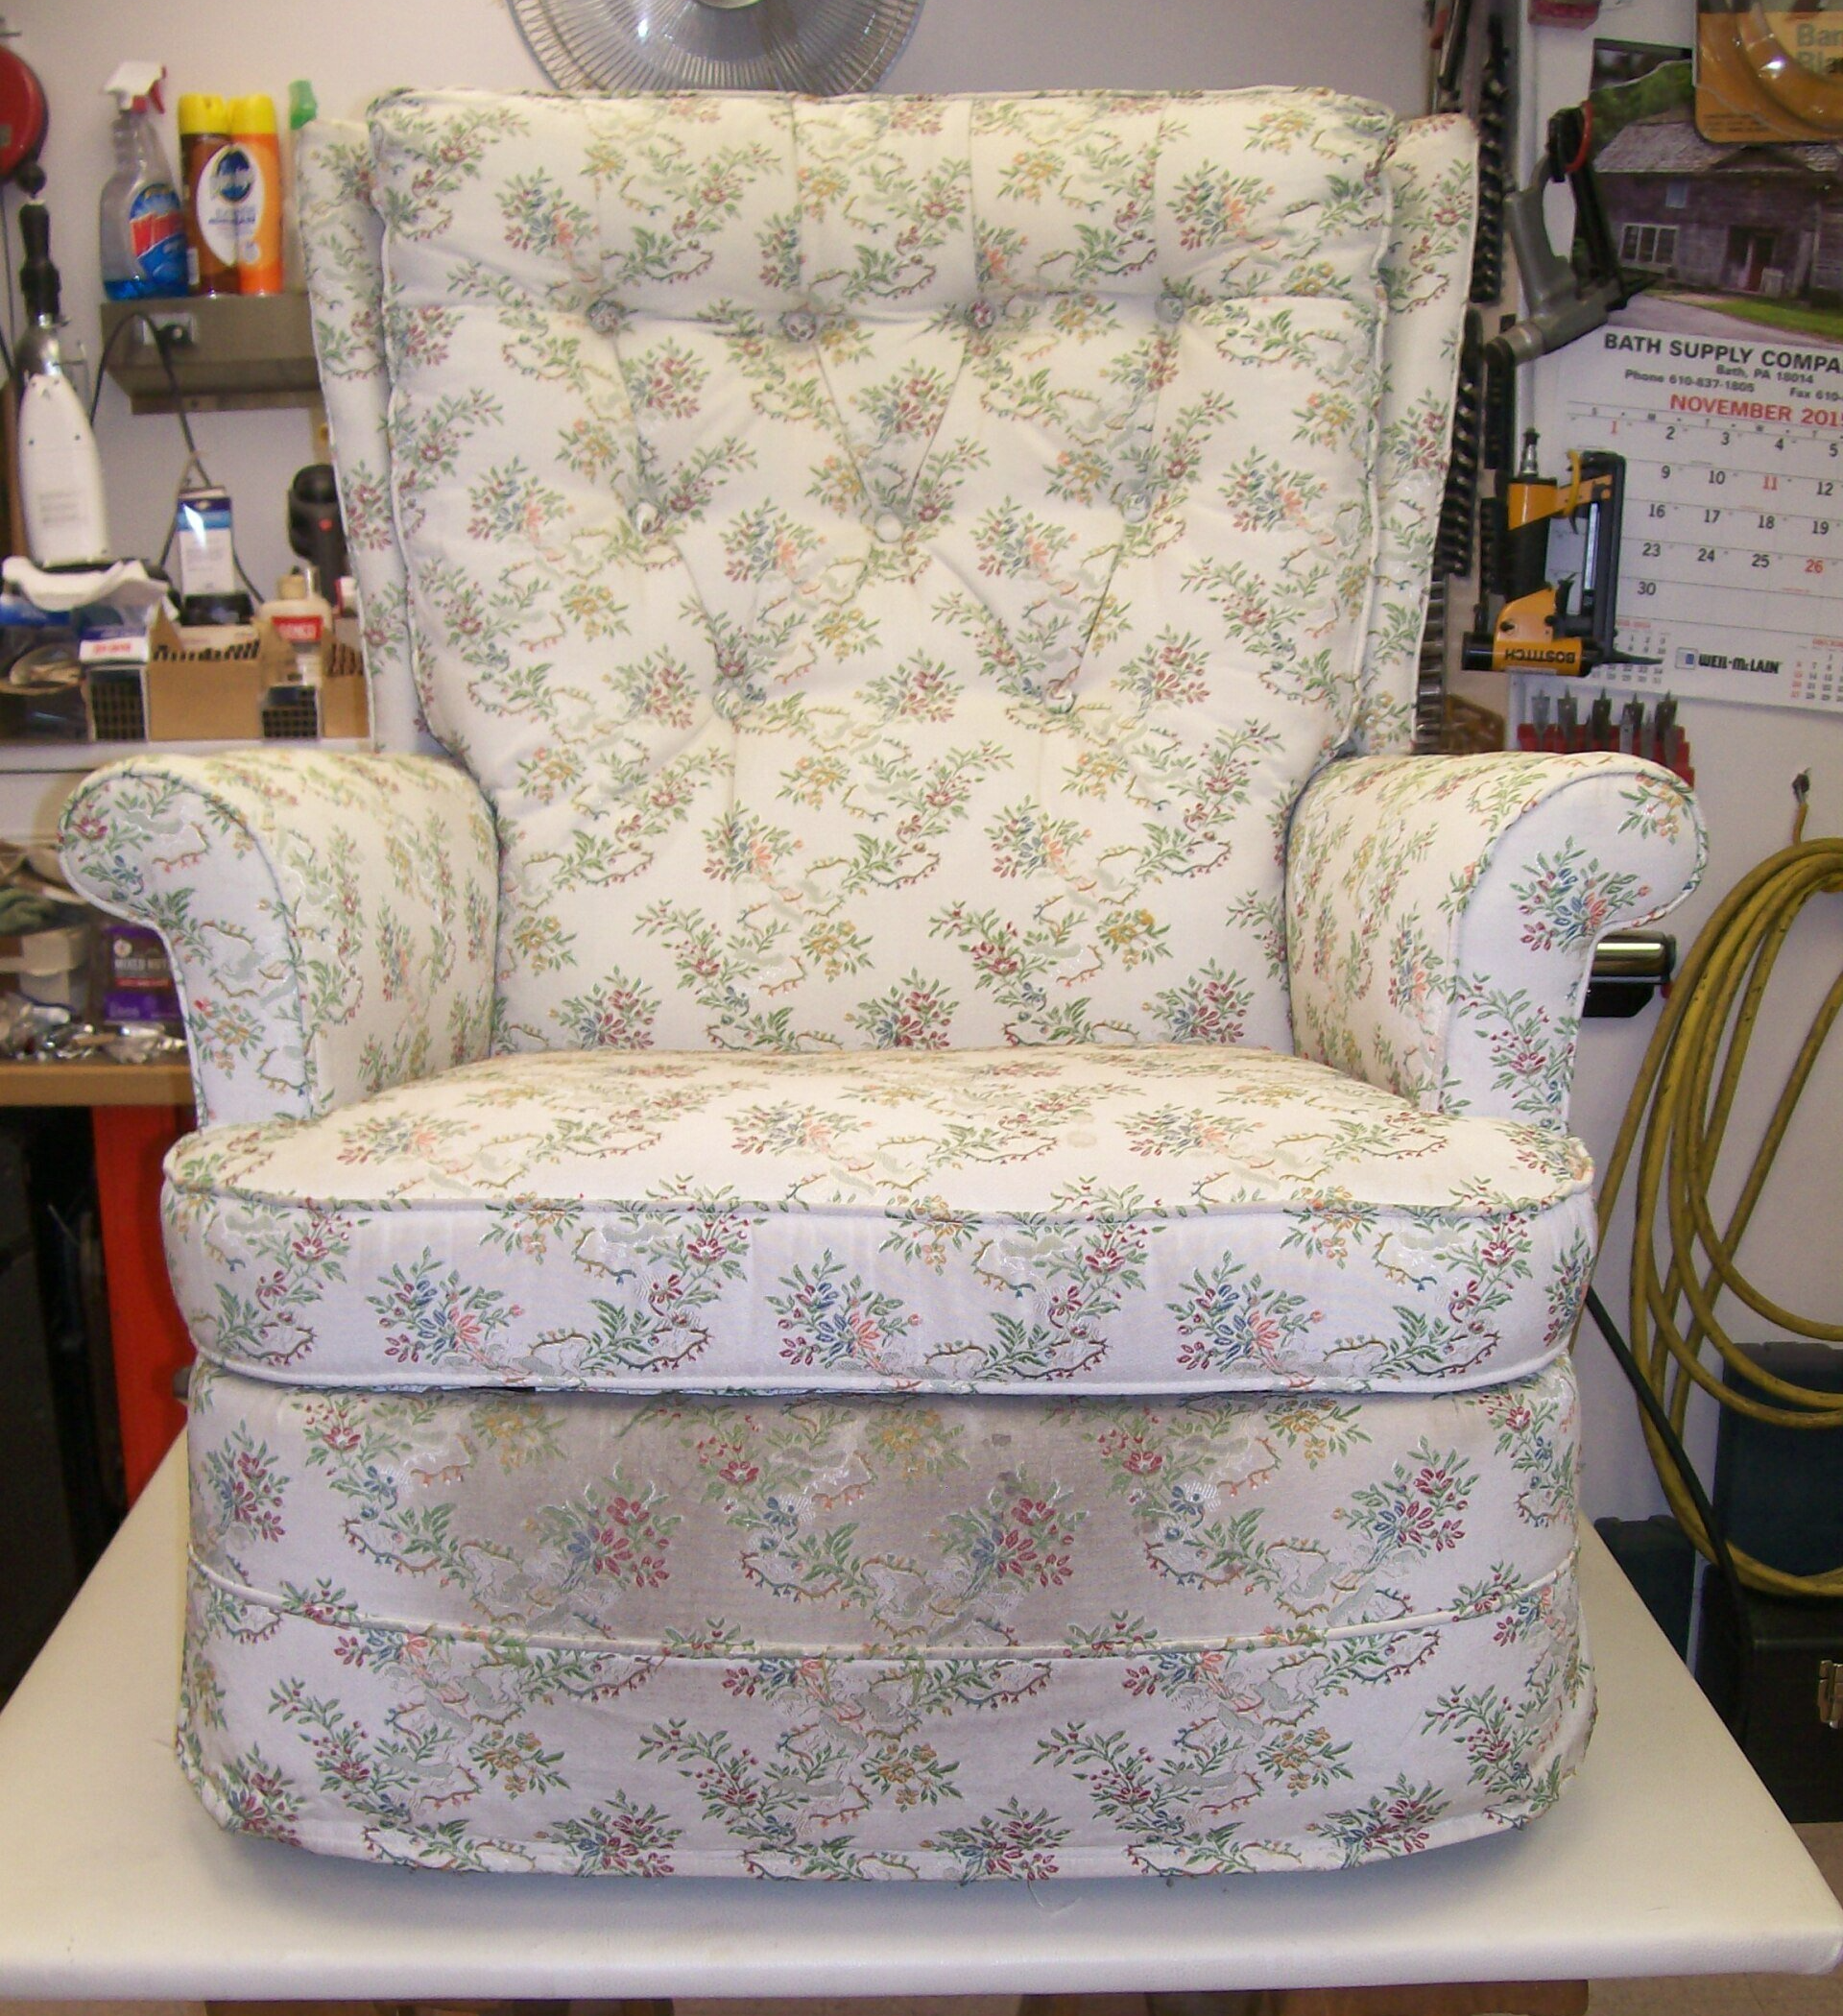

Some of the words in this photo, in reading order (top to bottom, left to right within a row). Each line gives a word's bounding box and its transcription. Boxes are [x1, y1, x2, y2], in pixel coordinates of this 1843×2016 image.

[1604, 332, 1662, 354] BATH
[1669, 340, 1755, 364] SUPPLY
[1760, 349, 1843, 374] COMPA
[1624, 369, 1664, 383] Phone
[1789, 386, 1810, 399] Fax
[1814, 389, 1843, 402] 610-
[1754, 368, 1771, 380] PA
[1777, 371, 1814, 384] 18014
[1669, 394, 1792, 422] NOVEMBER
[1610, 420, 1617, 433] 1
[1665, 425, 1675, 440] 2
[1720, 432, 1730, 445] 3
[1774, 438, 1784, 451] 4
[1829, 443, 1838, 457] 5
[1661, 465, 1671, 479] 9
[1708, 469, 1726, 485] 10
[1762, 475, 1778, 491] 11
[1816, 481, 1833, 496] 12
[1648, 503, 1666, 518] 16
[1704, 509, 1721, 523] 17
[1758, 515, 1775, 529] 18
[1811, 520, 1830, 535] 19
[1641, 541, 1662, 557] 23
[1697, 547, 1715, 562] 24
[1751, 553, 1770, 567] 25
[1805, 559, 1824, 573] 26
[1637, 581, 1657, 595] 30
[1504, 649, 1576, 664] BOSTITCH
